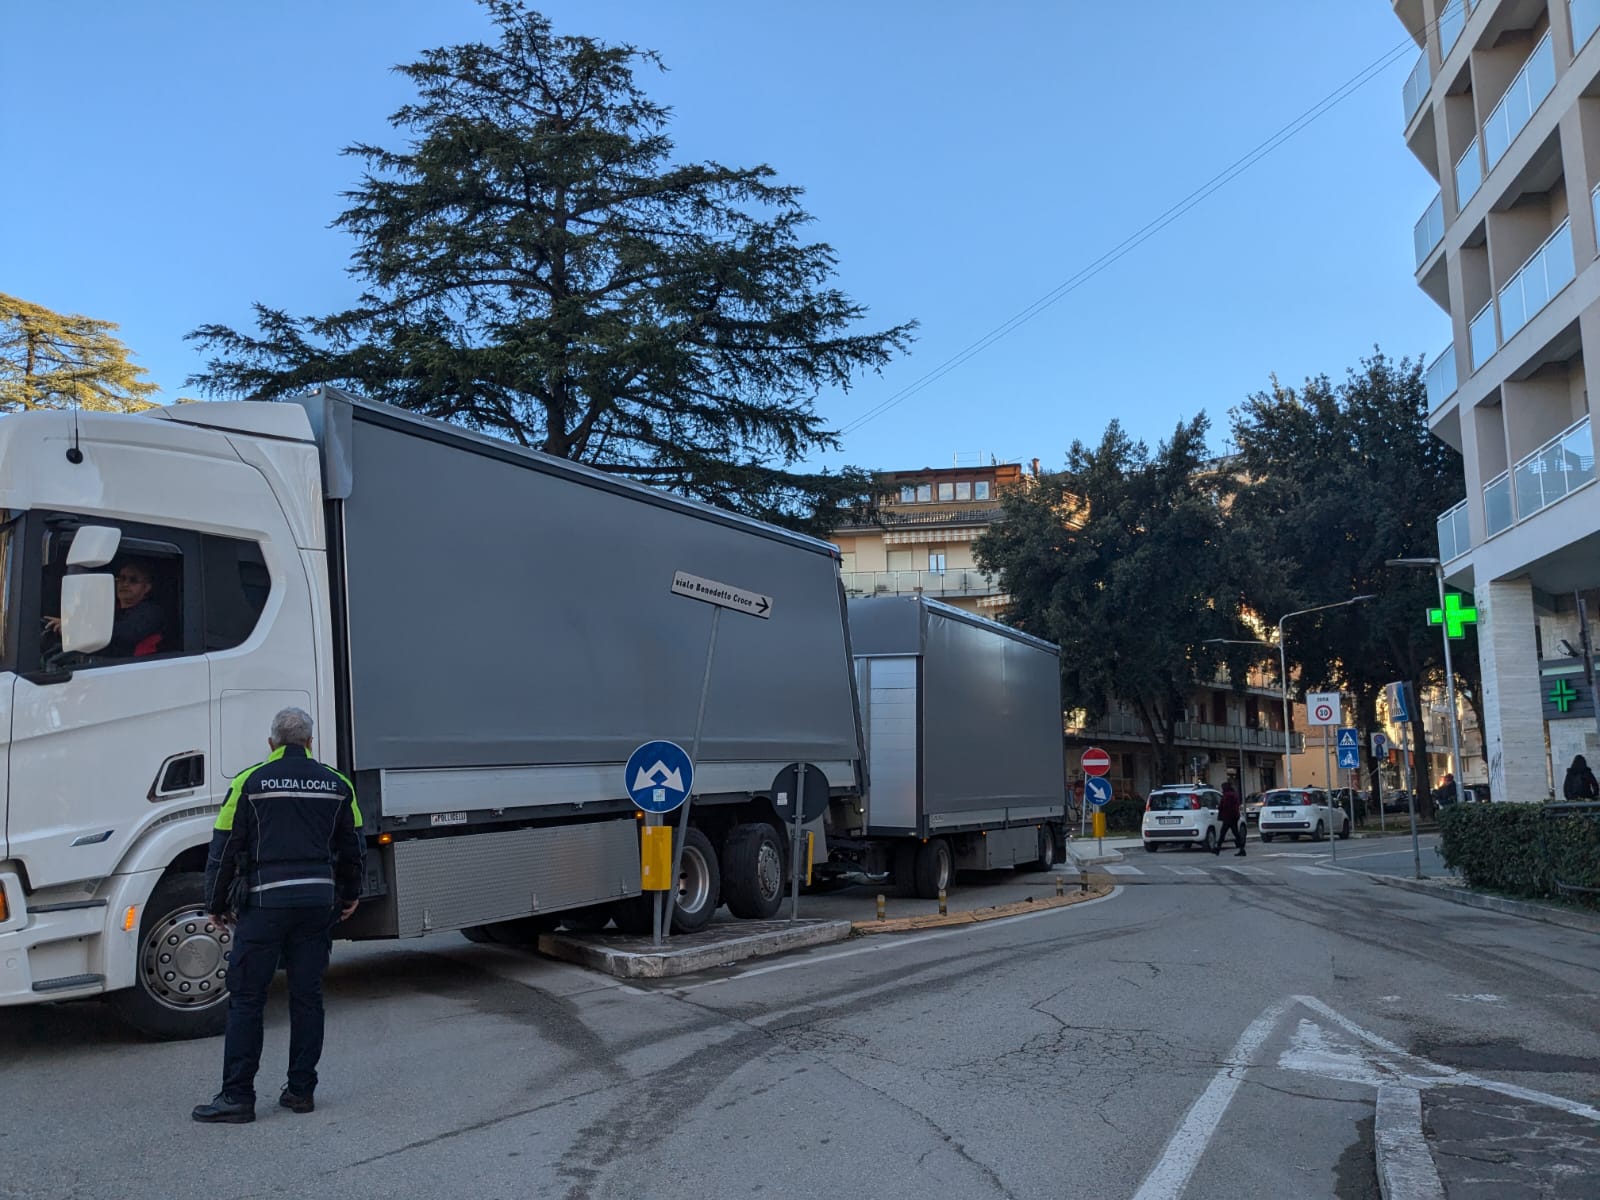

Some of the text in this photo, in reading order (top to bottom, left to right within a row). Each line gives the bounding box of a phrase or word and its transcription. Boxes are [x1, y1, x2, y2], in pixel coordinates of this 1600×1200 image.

[675, 579, 752, 607] viale Benedetto Croce
[1319, 709, 1329, 717] 30
[261, 778, 337, 791] POLIZIA LOCALE
